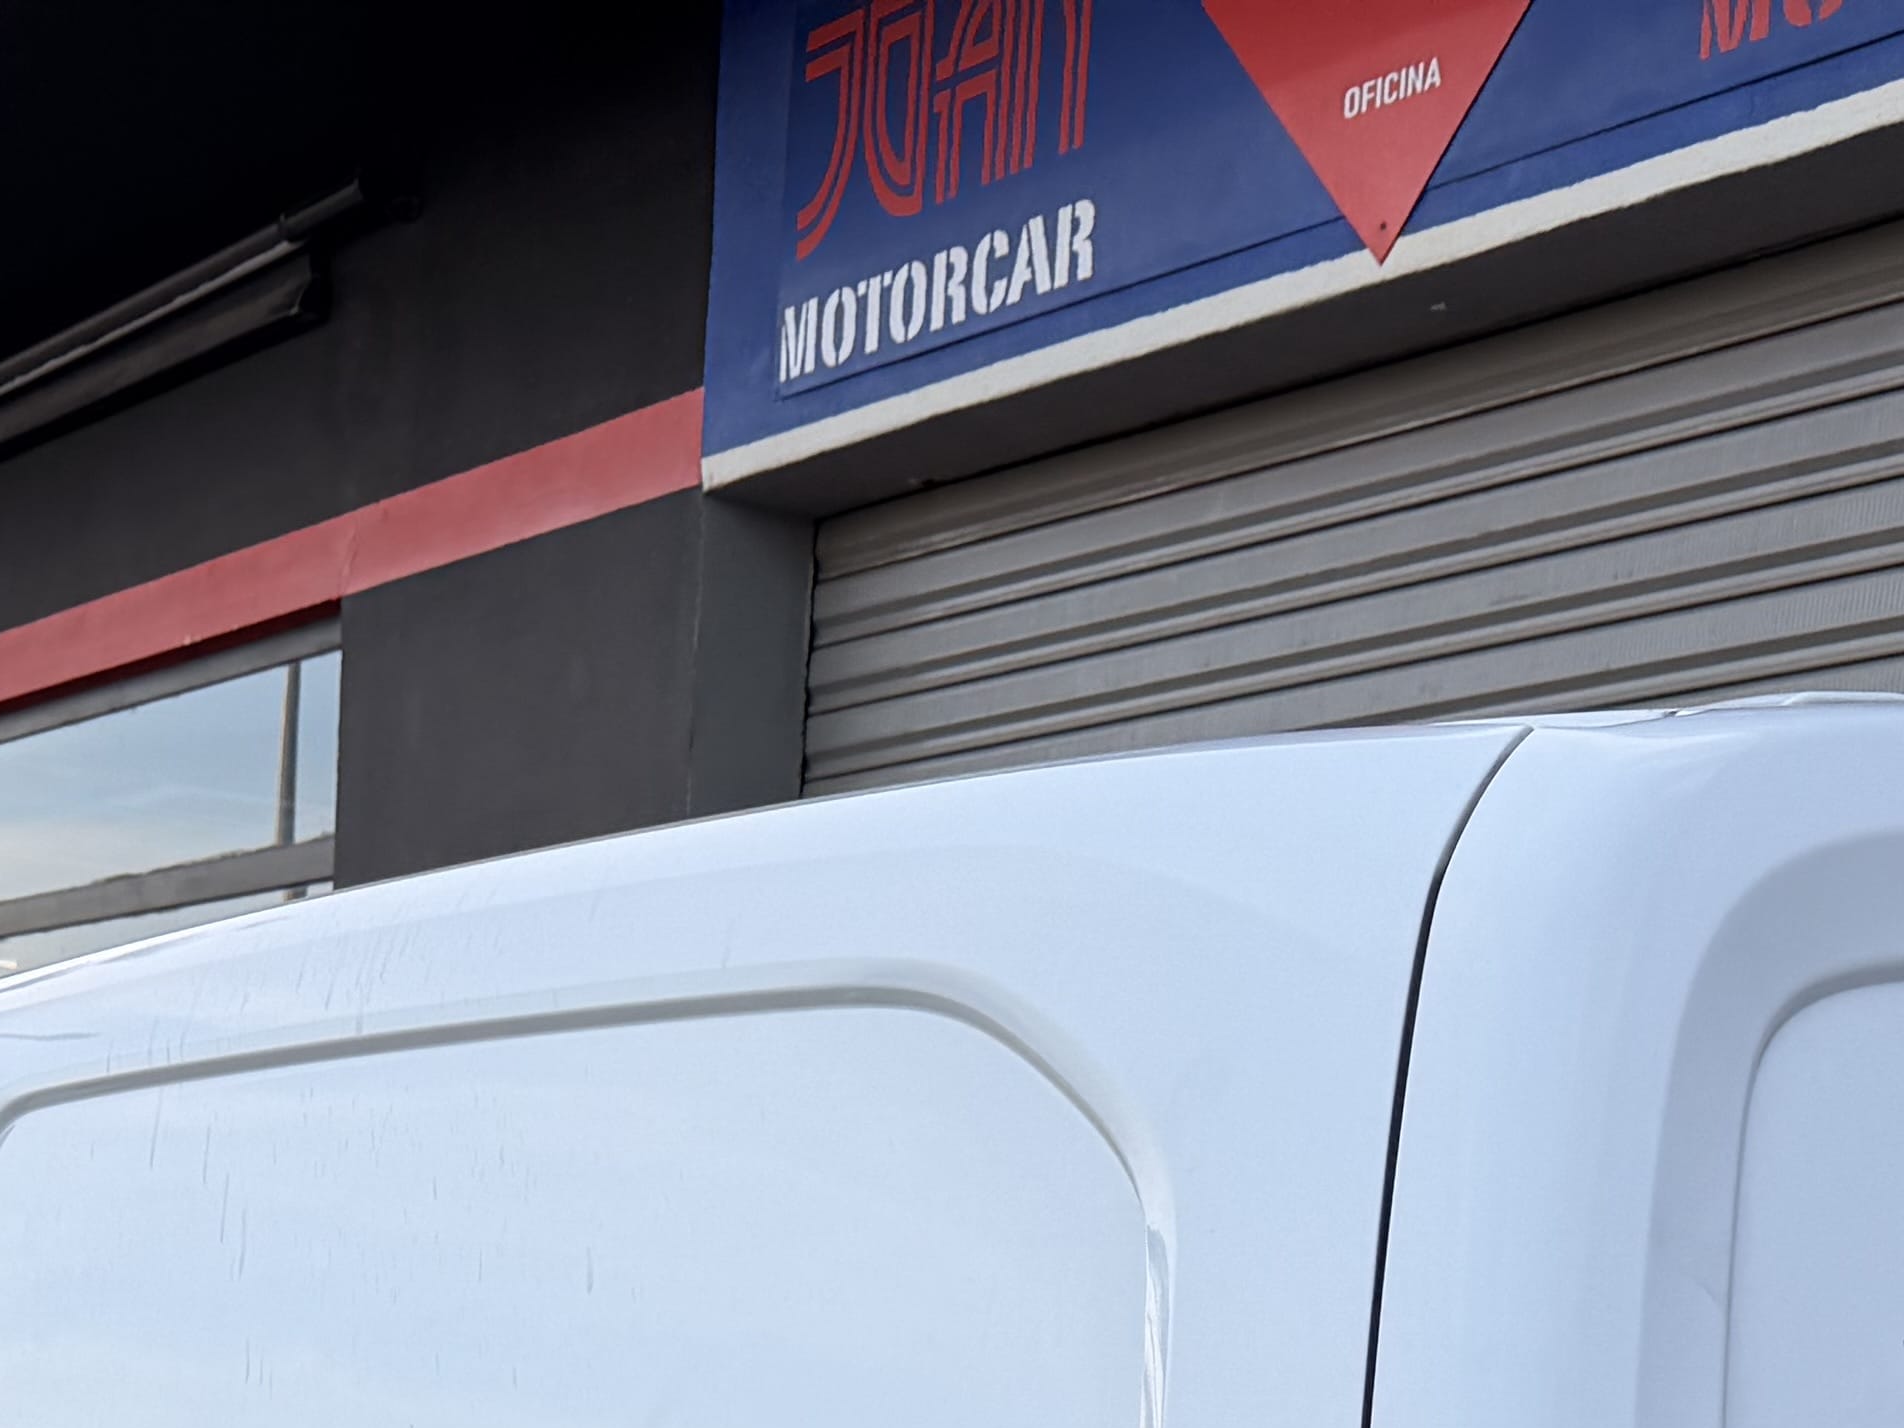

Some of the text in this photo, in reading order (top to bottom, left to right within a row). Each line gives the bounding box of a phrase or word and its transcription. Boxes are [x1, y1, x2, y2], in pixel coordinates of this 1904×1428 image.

[797, 0, 1092, 260] JUAN
[1344, 56, 1441, 119] OFICINA
[779, 199, 1096, 383] MOTORCAR
